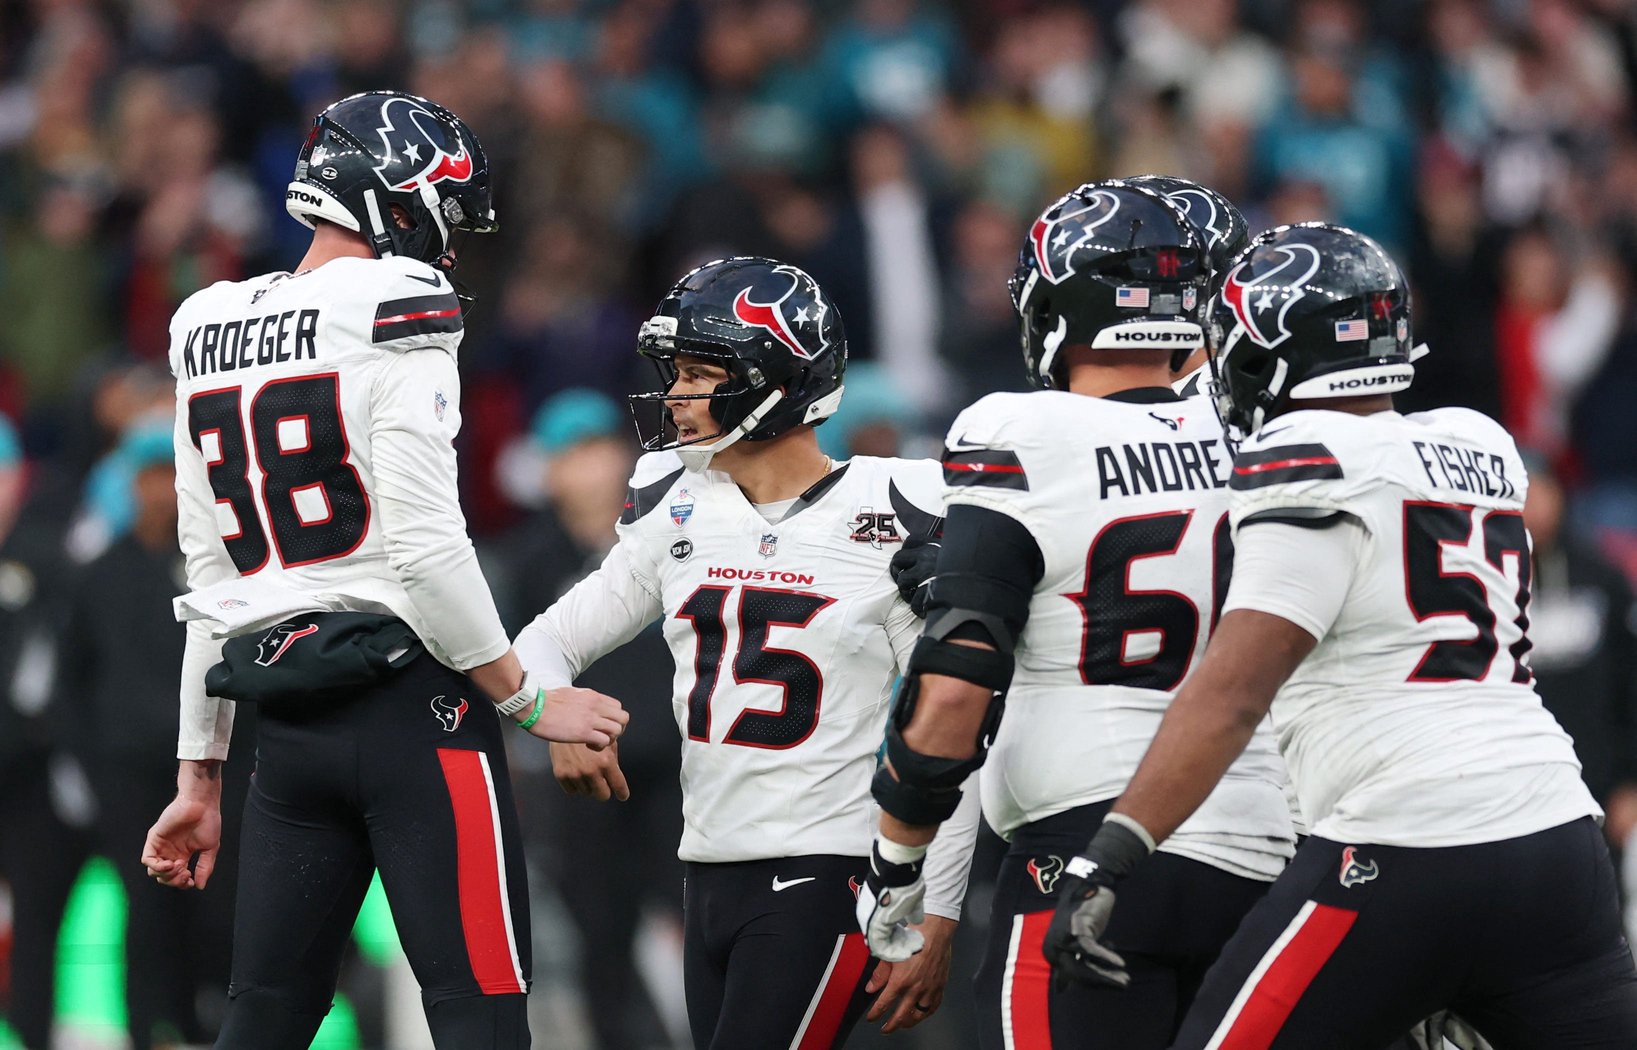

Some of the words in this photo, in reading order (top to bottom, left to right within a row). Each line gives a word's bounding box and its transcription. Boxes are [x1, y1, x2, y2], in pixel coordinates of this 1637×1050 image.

[184, 309, 320, 380] KROEGER
[1115, 332, 1201, 342] HOUSTON
[188, 371, 371, 577] 38
[1095, 439, 1237, 500] ANDRE
[1412, 441, 1515, 498] FISHER
[855, 513, 898, 542] 25
[707, 566, 815, 585] HOUSTON
[674, 584, 839, 750] 15
